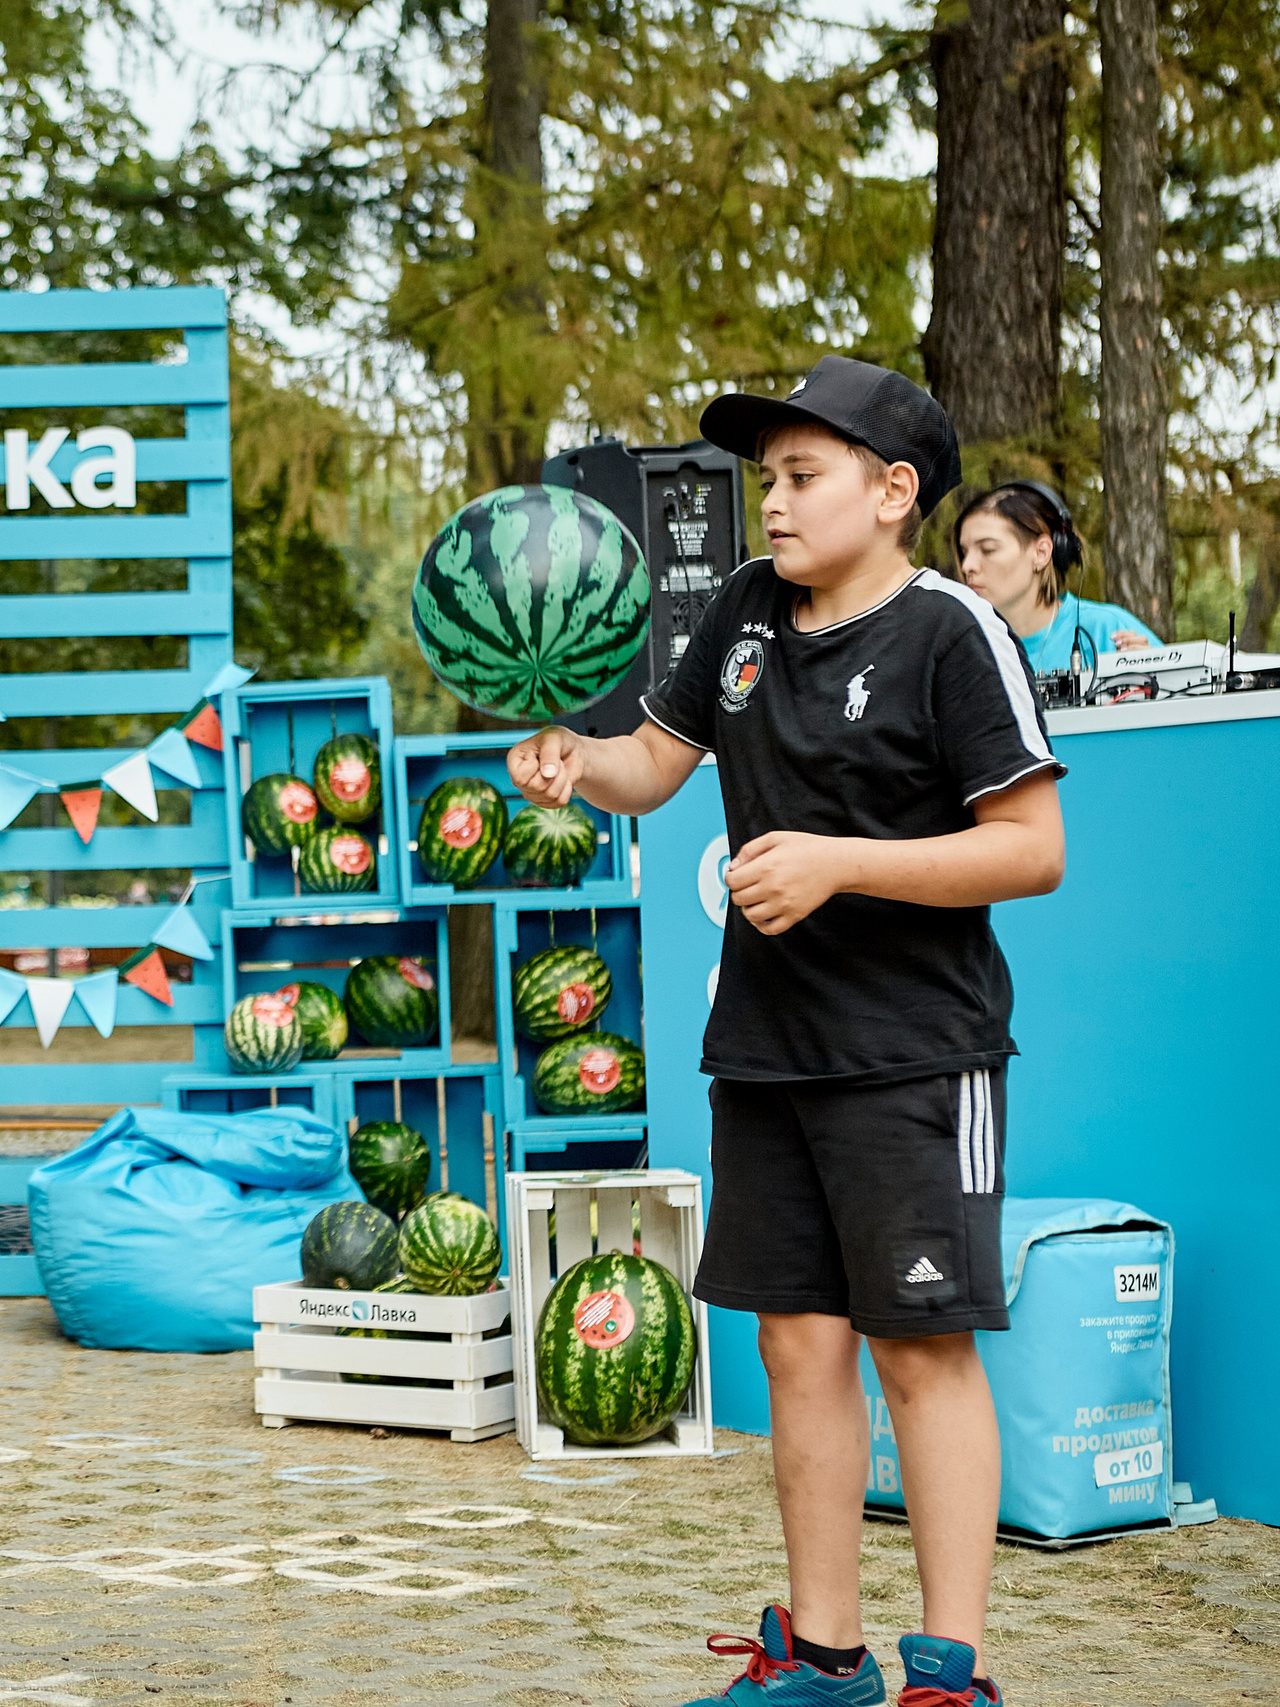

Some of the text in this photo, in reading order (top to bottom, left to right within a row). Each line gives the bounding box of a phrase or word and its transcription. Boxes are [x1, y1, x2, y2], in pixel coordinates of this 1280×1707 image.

[1116, 655, 1165, 667] Pioneer
[905, 1272, 944, 1284] adidas
[1120, 1272, 1158, 1293] 3214M
[300, 1299, 417, 1322] Яндекс Лавка
[1080, 1316, 1124, 1328] закажите
[1107, 1330, 1113, 1340] в
[1075, 1399, 1154, 1428] доставка
[1052, 1426, 1159, 1457] продуктов
[1109, 1449, 1152, 1478] от 10
